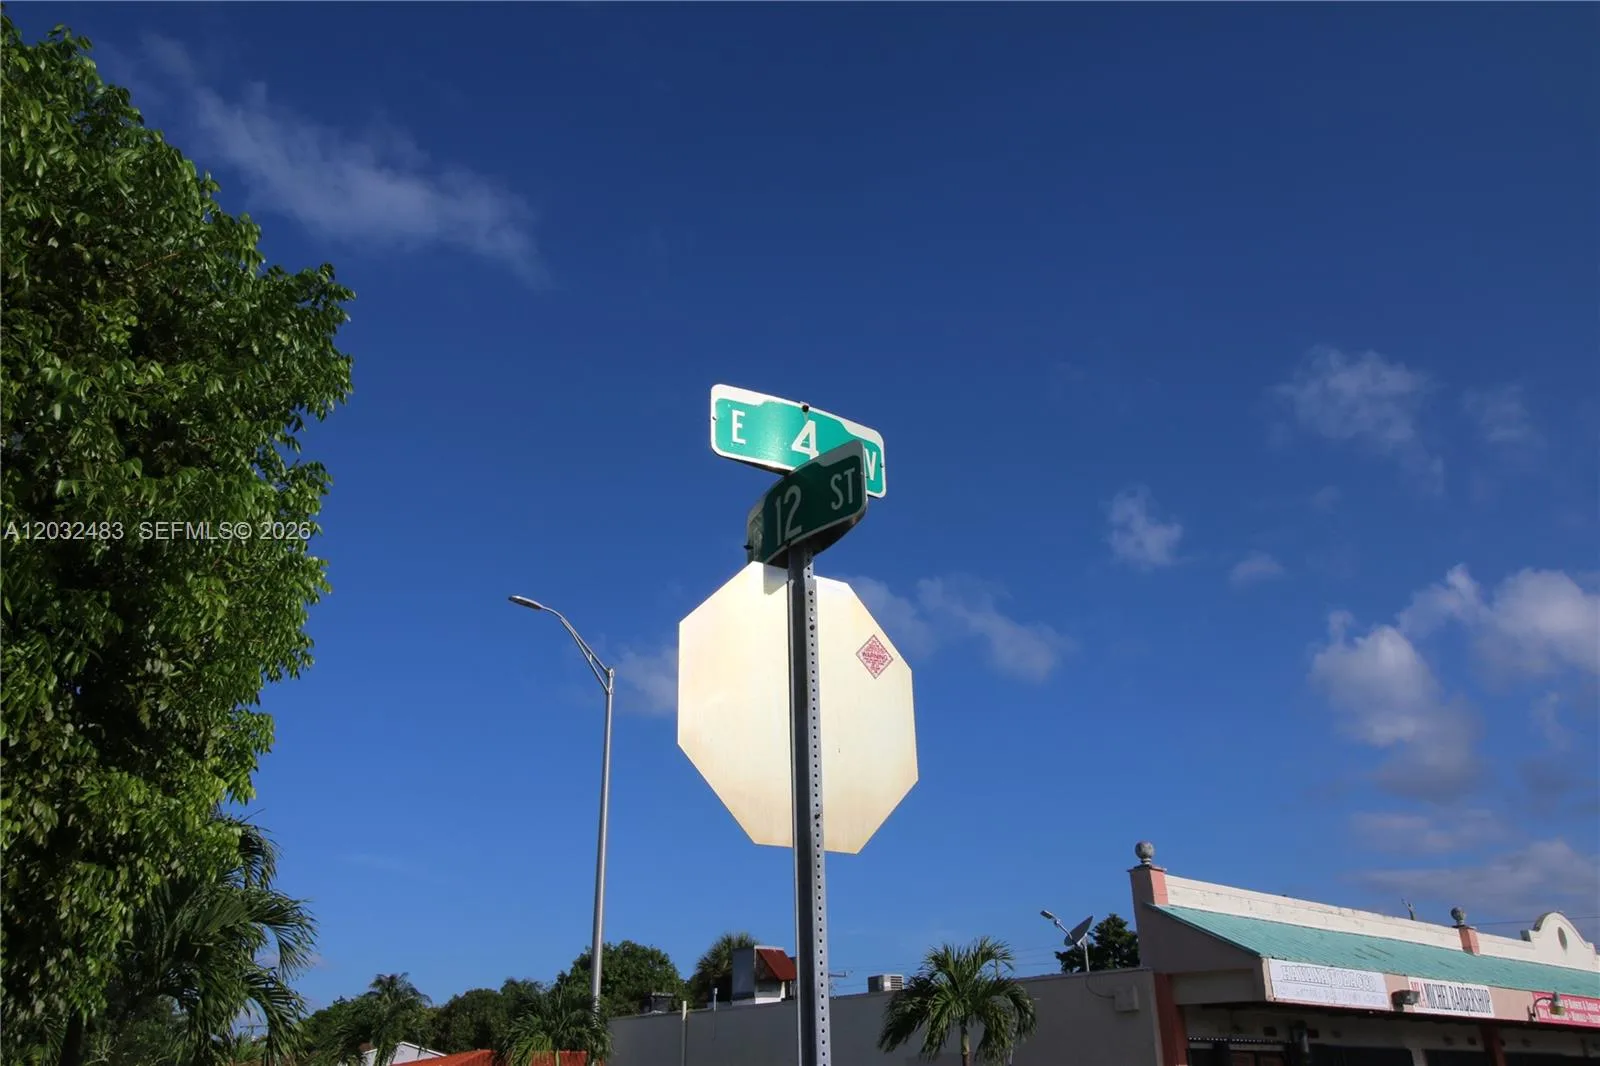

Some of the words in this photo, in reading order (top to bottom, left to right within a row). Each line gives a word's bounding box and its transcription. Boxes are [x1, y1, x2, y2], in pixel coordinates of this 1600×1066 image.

[731, 409, 746, 445] E
[791, 419, 819, 460] 4
[864, 447, 876, 481] V
[774, 484, 803, 547] 12
[830, 467, 856, 511] ST
